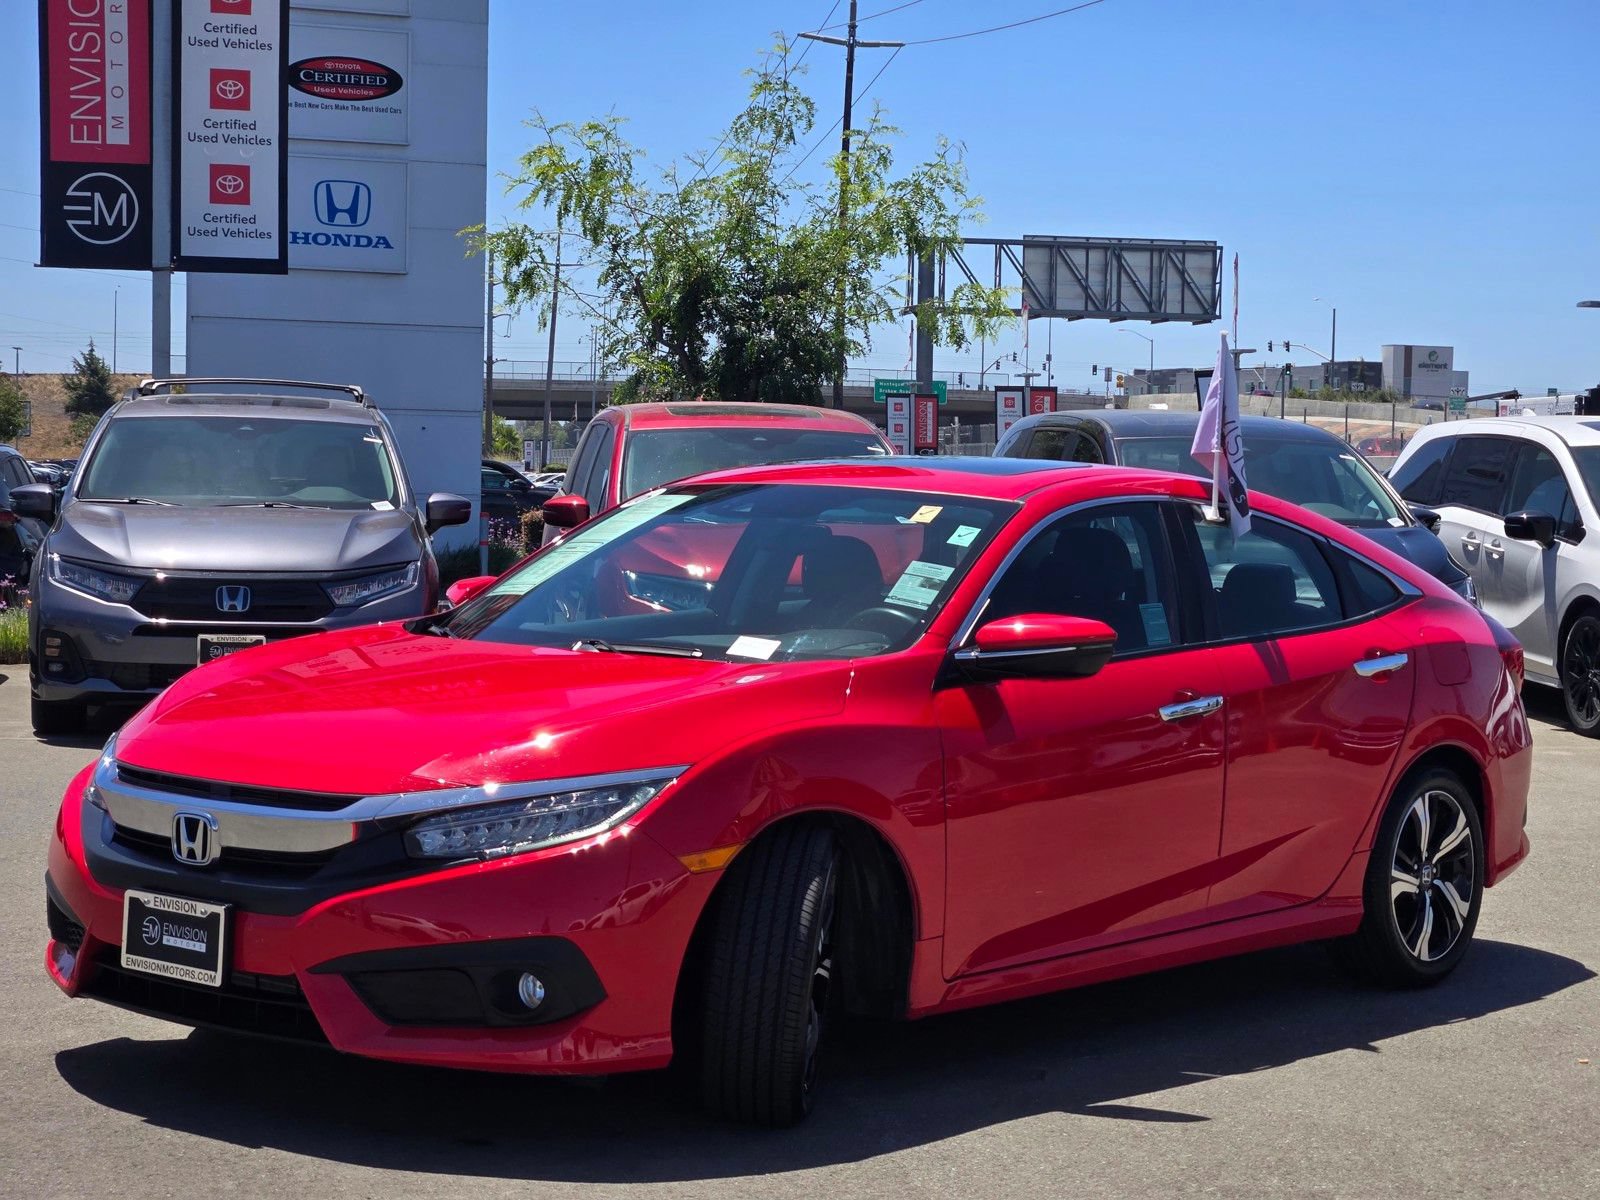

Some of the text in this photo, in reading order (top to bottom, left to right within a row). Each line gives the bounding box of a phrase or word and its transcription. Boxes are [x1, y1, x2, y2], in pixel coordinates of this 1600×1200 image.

[203, 22, 257, 35] Certified
[187, 36, 273, 51] Used Vehicles
[300, 69, 387, 86] CERTIFIED
[338, 87, 374, 96] Vehicles
[334, 103, 350, 111] Make
[350, 104, 361, 112] The
[361, 105, 374, 113] Best
[203, 118, 257, 131] Certified
[187, 132, 272, 146] Used Vehicles
[203, 213, 257, 225] Certified
[187, 227, 272, 240] Used Vehicles
[289, 231, 394, 249] HONDA
[153, 896, 197, 915] ENVISION
[163, 922, 208, 943] ENVISION
[125, 956, 217, 985] ENVISIONMOTORS.COM
